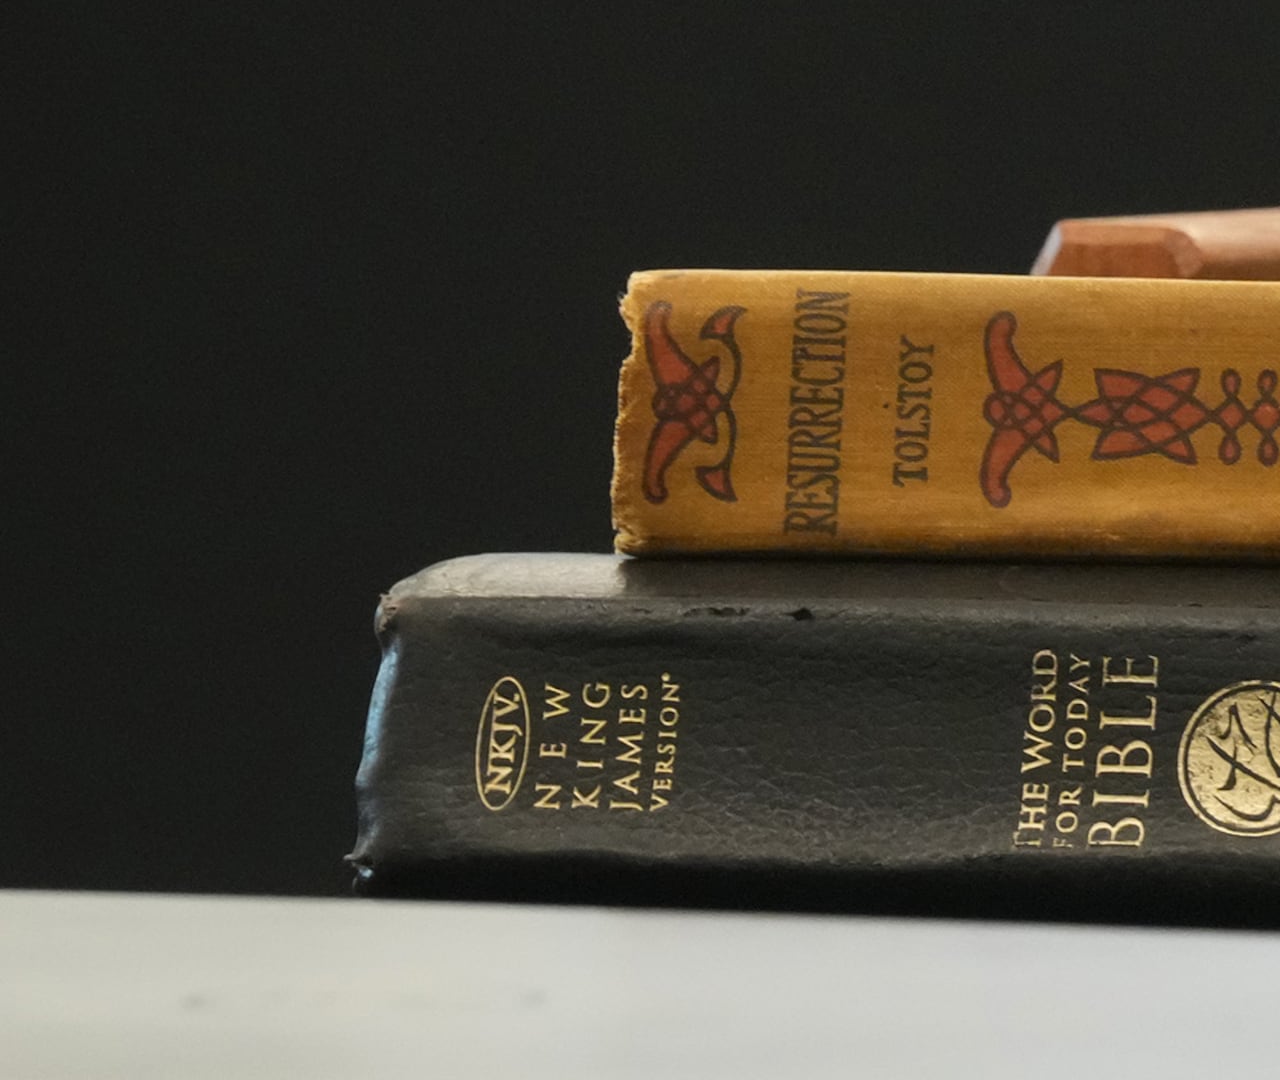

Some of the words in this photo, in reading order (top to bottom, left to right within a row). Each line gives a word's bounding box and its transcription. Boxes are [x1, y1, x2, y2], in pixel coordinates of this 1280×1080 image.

[784, 288, 851, 537] RESURRECTION
[892, 334, 935, 488] TOLSTOY
[533, 682, 572, 810] NEW
[571, 682, 611, 809] KING
[609, 684, 648, 811] JAMES
[1021, 648, 1060, 773] WORD
[1062, 653, 1092, 773] TODAY
[1086, 655, 1159, 849] BIBLE
[1012, 782, 1051, 850] THE
[1053, 785, 1083, 849] FOR
